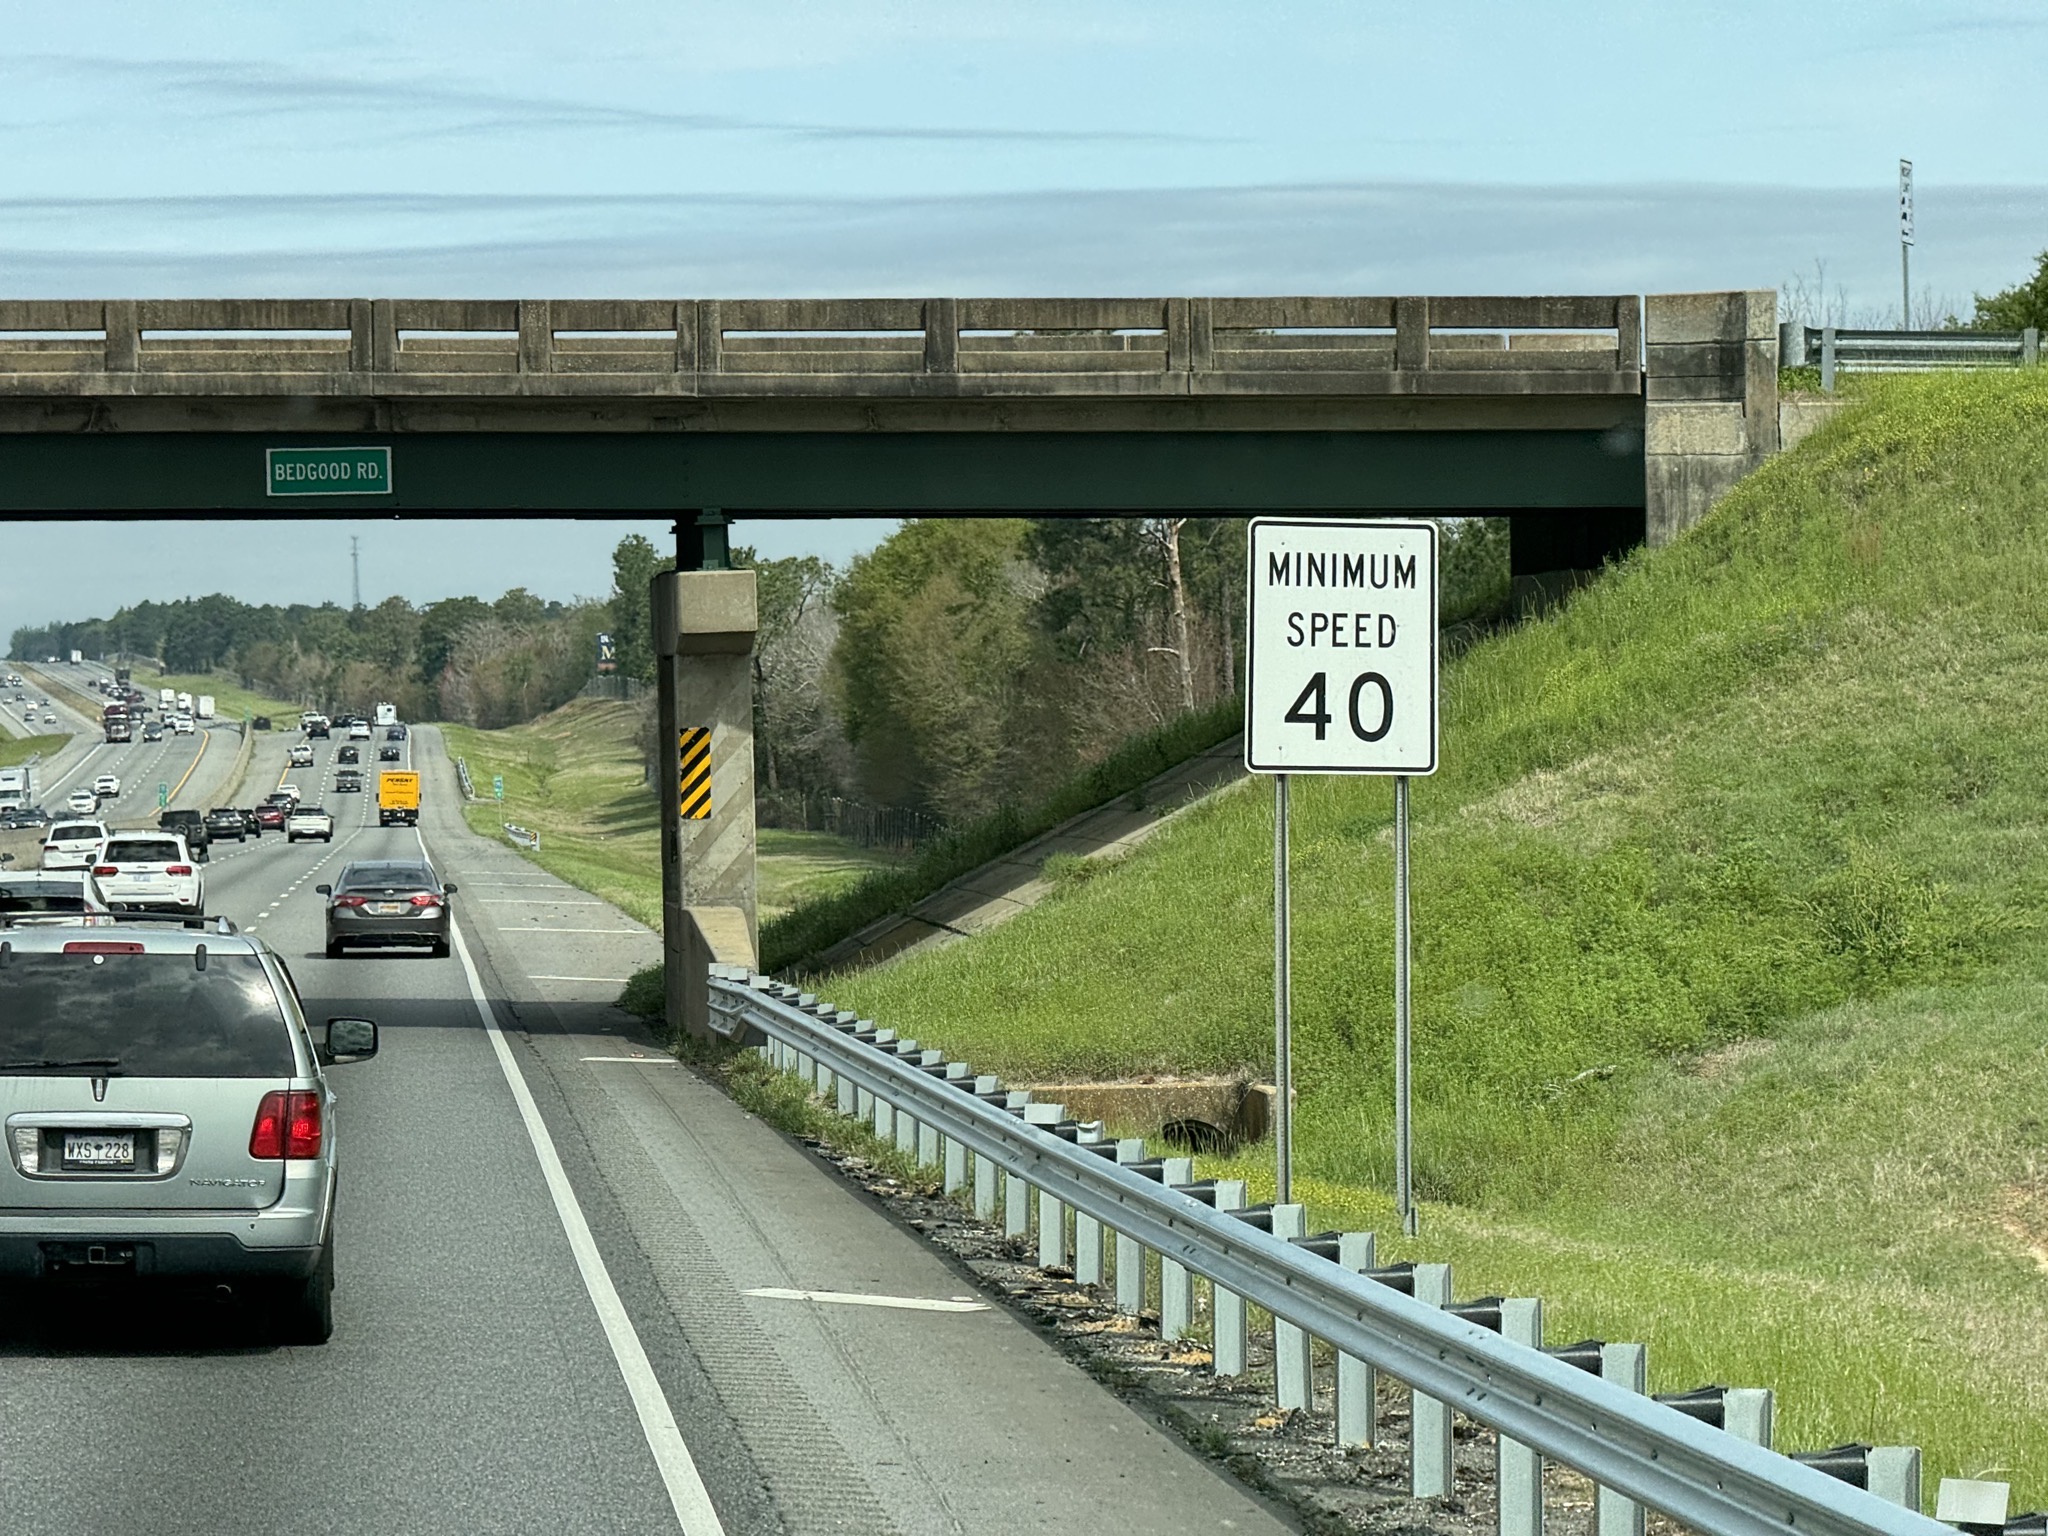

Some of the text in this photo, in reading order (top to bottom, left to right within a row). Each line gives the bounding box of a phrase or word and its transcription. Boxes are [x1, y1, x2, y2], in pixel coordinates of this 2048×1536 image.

[275, 462, 383, 480] BEDGOOD RD.
[1268, 551, 1416, 589] MINIMUM
[1287, 611, 1397, 649] SPEED
[1284, 671, 1394, 743] 40
[67, 1142, 129, 1159] WXS 228
[189, 1178, 266, 1188] NAVIGATOR
